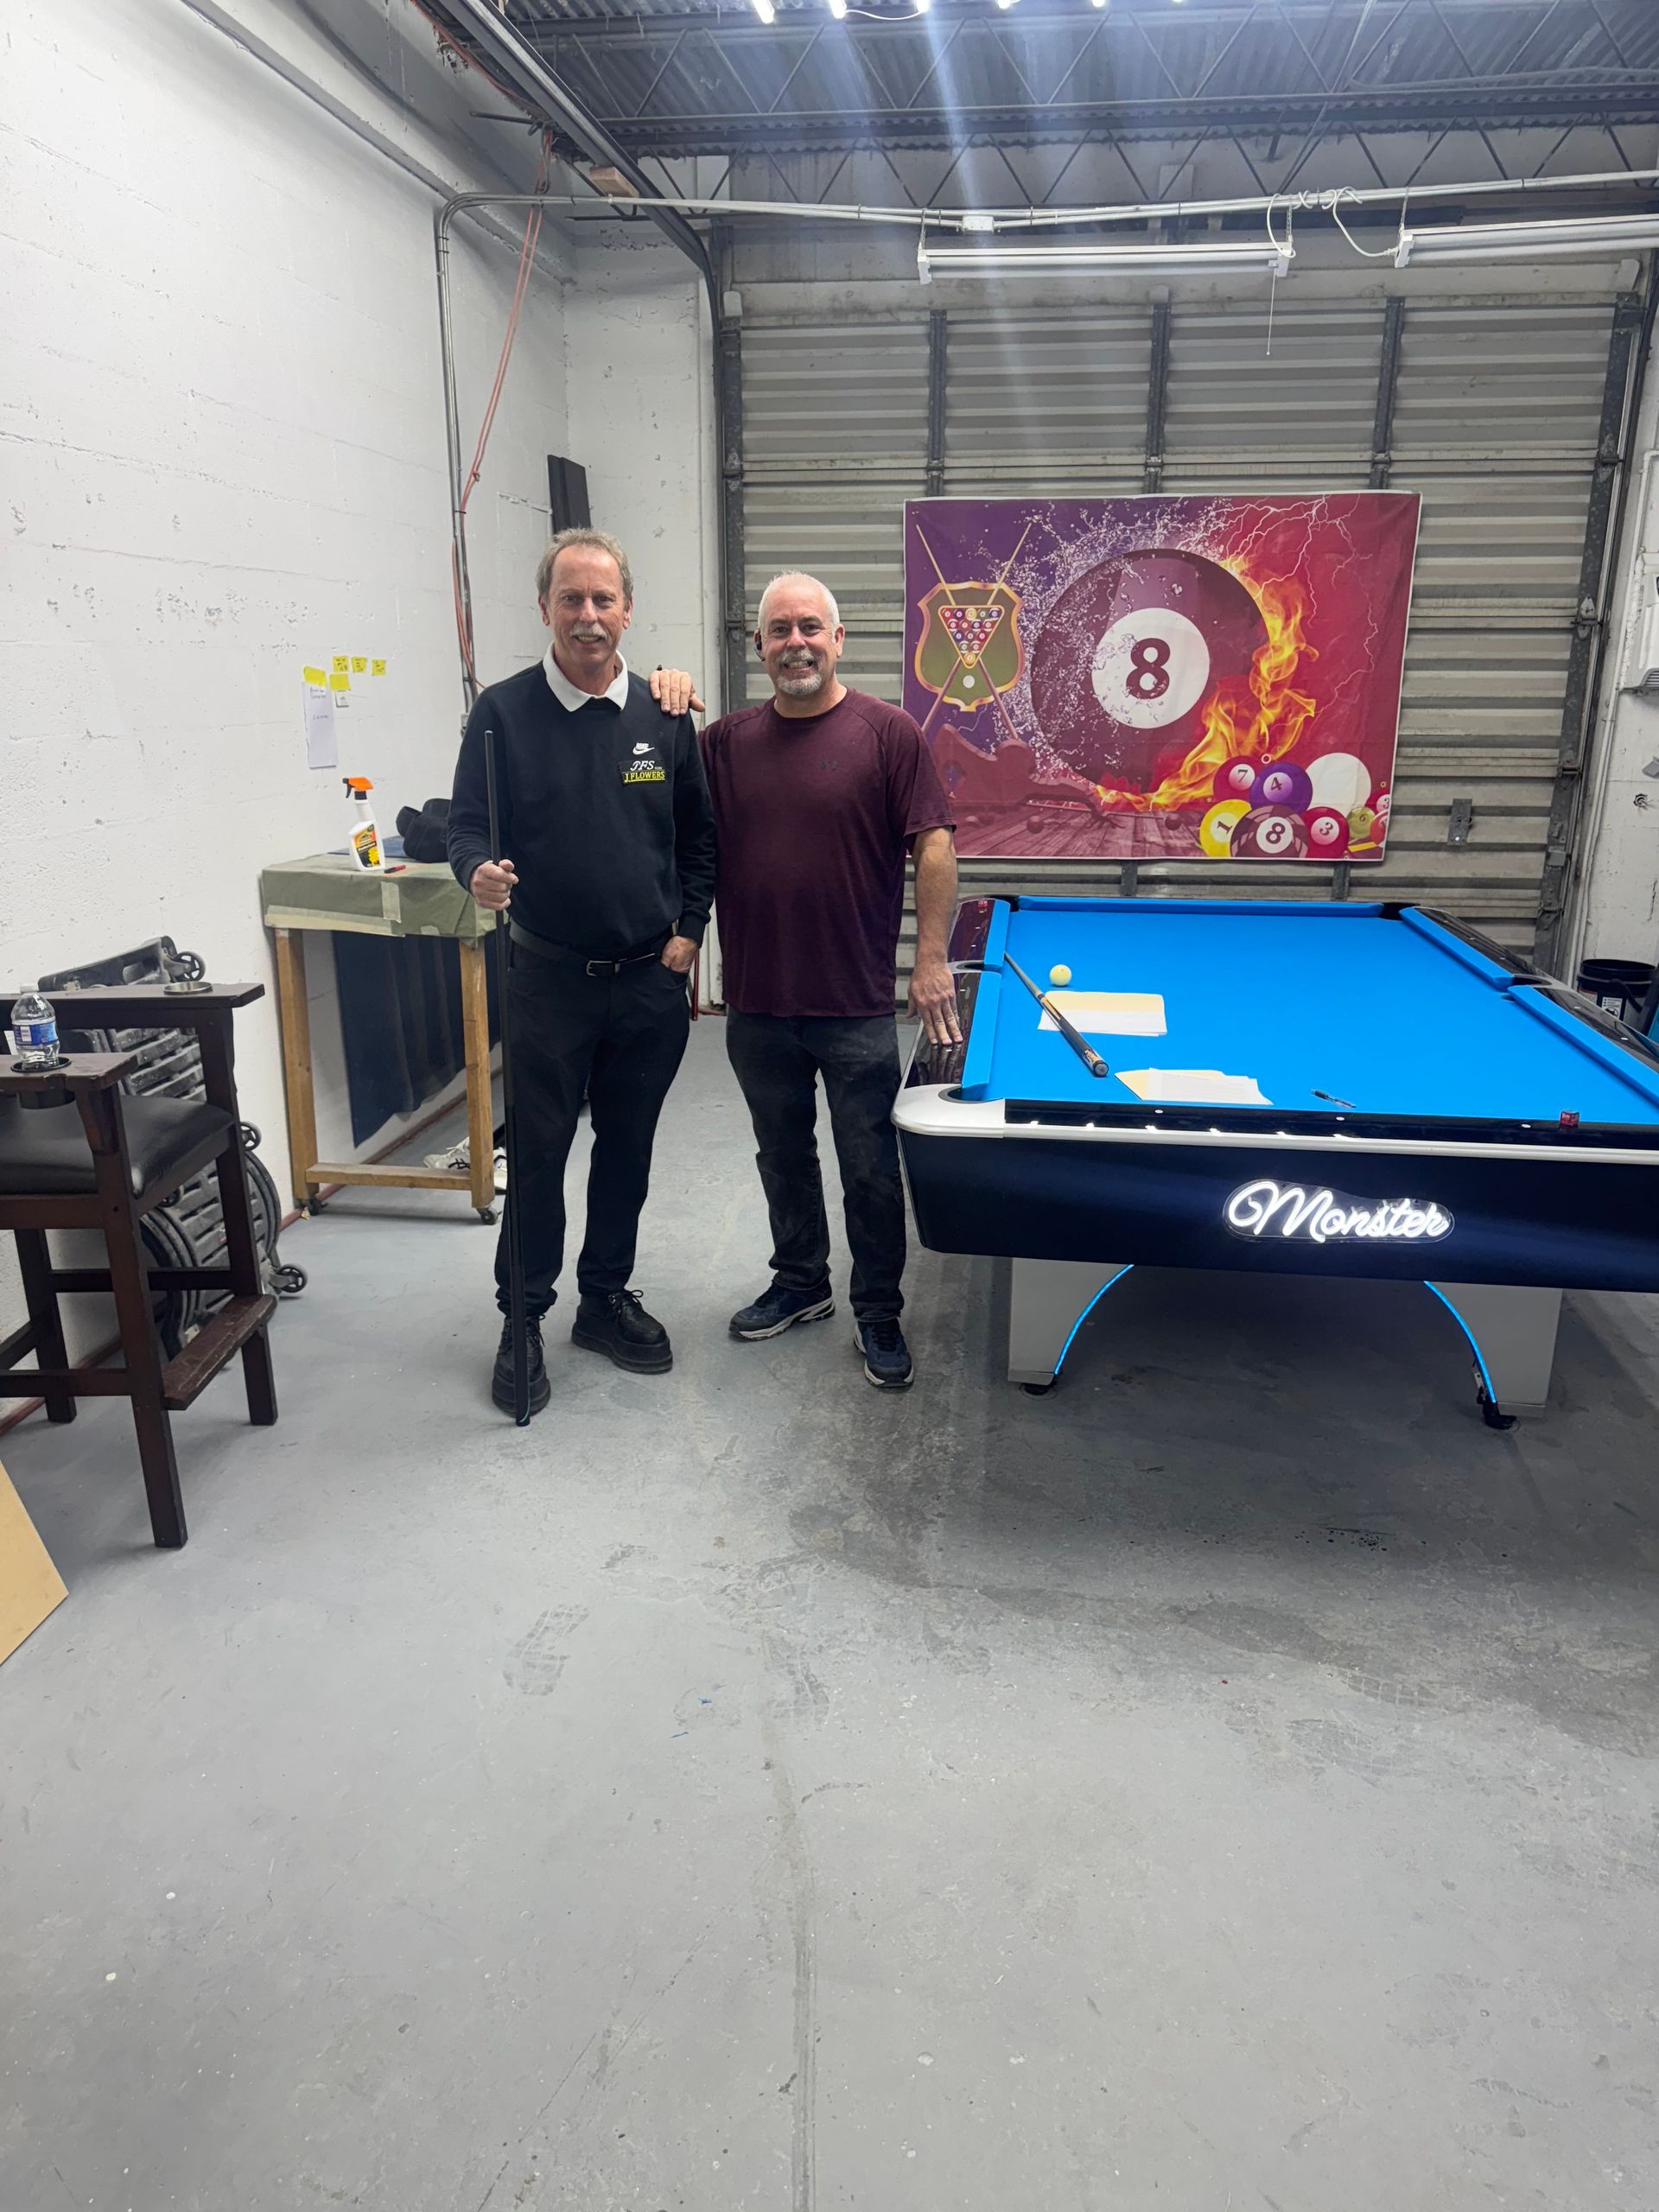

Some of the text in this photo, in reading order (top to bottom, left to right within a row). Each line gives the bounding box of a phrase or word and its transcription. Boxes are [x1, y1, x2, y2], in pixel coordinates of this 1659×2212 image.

[1126, 638, 1171, 700] 8
[1237, 769, 1249, 783] 7
[1270, 777, 1282, 791] 4
[1217, 820, 1233, 835] 1
[1265, 822, 1286, 844] 8
[1319, 822, 1334, 836] 3
[1228, 1180, 1450, 1243] Monster
